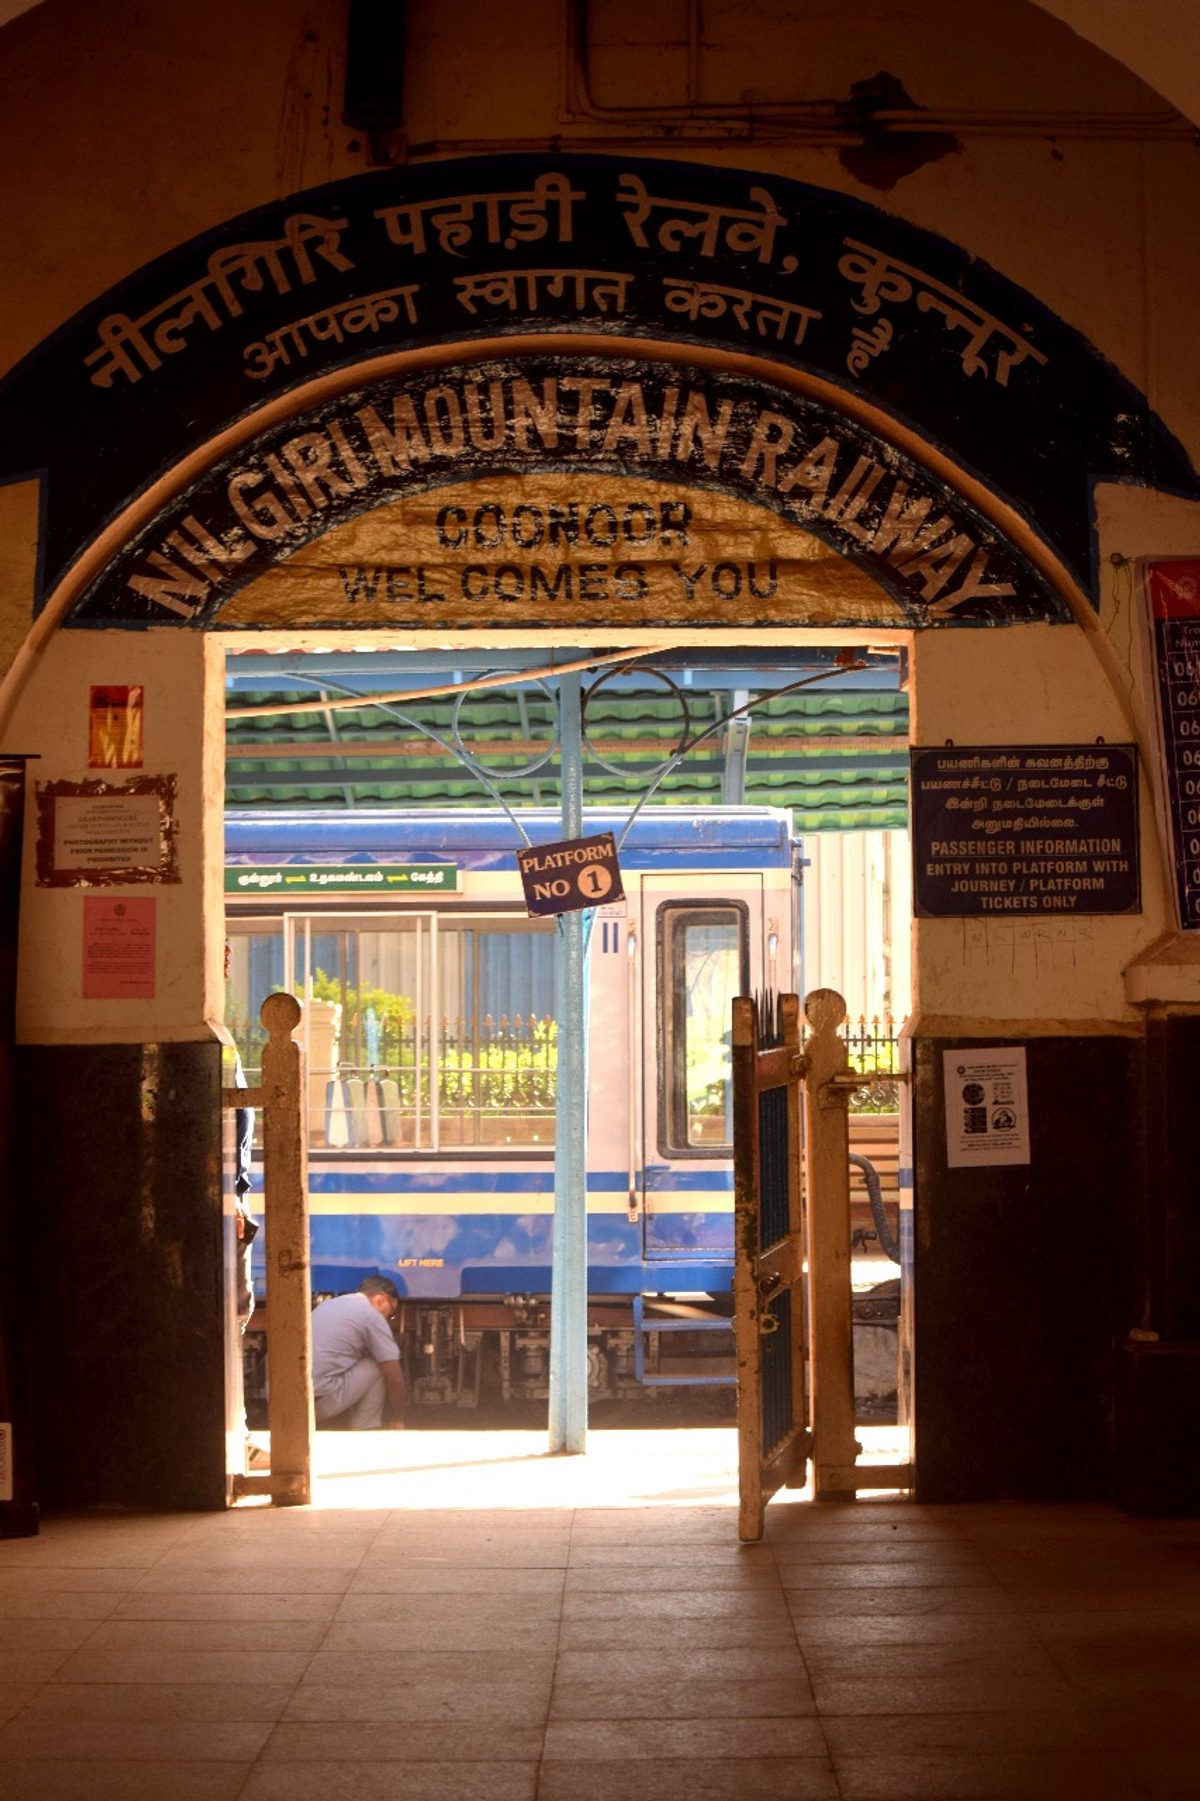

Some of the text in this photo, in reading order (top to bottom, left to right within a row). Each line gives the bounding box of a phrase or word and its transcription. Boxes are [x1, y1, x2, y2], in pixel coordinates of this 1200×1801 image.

[83, 172, 1049, 388] नीलगिरि पहाड़ी रेलवे, कुन्नूर
[243, 269, 894, 381] आपका स्वागत करता है
[127, 376, 1018, 619] NILGIRI MOUNTAIN RAILWAY
[436, 501, 693, 549] COONOOR
[672, 561, 780, 600] YOU
[521, 843, 613, 874] PLATFORM
[931, 838, 1121, 856] PASSENGER INFORMATION
[926, 860, 1129, 876] ENTRY INTO PLATFORM WITH
[532, 870, 603, 901] NO 1
[951, 880, 1015, 893] JOURNEY
[1029, 878, 1105, 891] PLATFORM
[980, 895, 1078, 909] TICKETS ONLY
